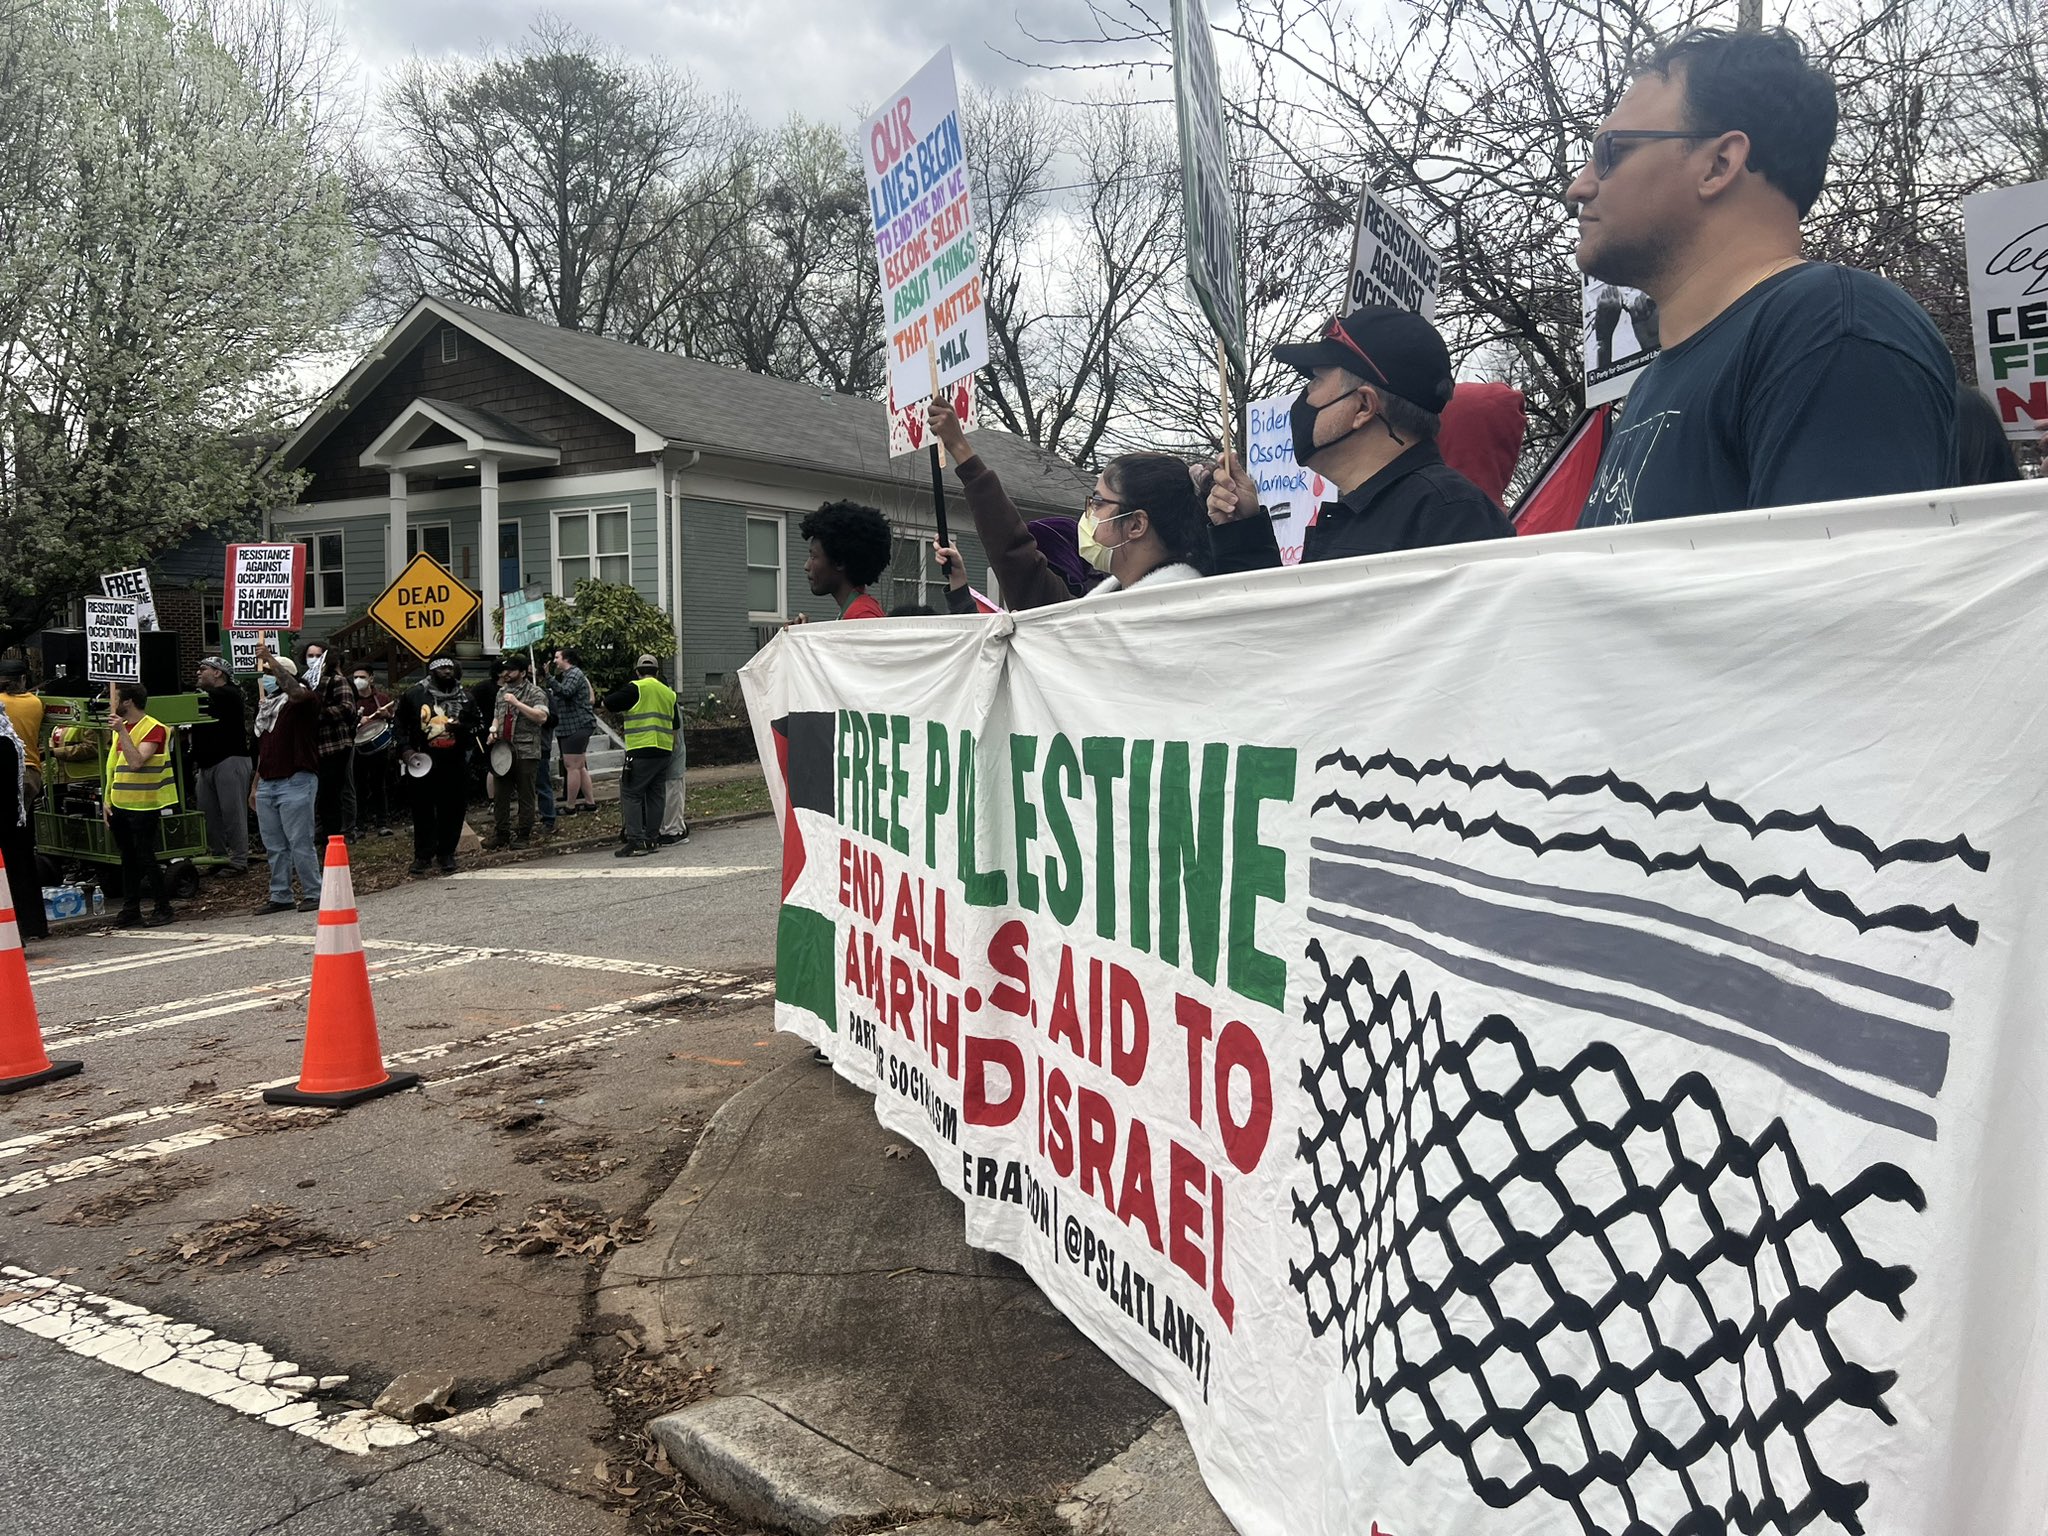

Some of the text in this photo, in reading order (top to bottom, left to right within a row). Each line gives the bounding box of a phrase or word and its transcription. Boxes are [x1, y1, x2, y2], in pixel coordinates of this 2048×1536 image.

[871, 96, 916, 175] OUR
[870, 110, 962, 231] LIVES BEGIN
[876, 167, 965, 259] TO END THE DAY WE
[884, 192, 970, 290] BECOME SILENT
[1363, 194, 1439, 295] RESISTANCE
[893, 231, 975, 324] ABOUT THINGS
[1370, 245, 1425, 311] AGAINST
[893, 275, 982, 363] THAT MATTER
[238, 549, 291, 560] RESISTANCE
[245, 561, 282, 572] AGAINST
[105, 571, 146, 597] FREE
[237, 573, 290, 584] OCCUPATION
[238, 588, 289, 599] IS A HUMAN
[398, 585, 450, 606] DEAD
[88, 602, 135, 615] RESISTANCE
[95, 614, 128, 626] AGAINST
[237, 600, 288, 619] RIGHT!
[405, 609, 445, 629] END
[89, 626, 137, 639] OCCUPATION
[90, 641, 99, 652] IS
[106, 642, 137, 654] HUMAN
[91, 653, 137, 674] RIGHT!
[838, 709, 910, 857] FREE
[838, 838, 884, 926] END
[892, 871, 960, 980] ALL
[1047, 944, 1149, 1087] AID
[1175, 992, 1273, 1175] TO
[1037, 1054, 1235, 1335] ISRAEL
